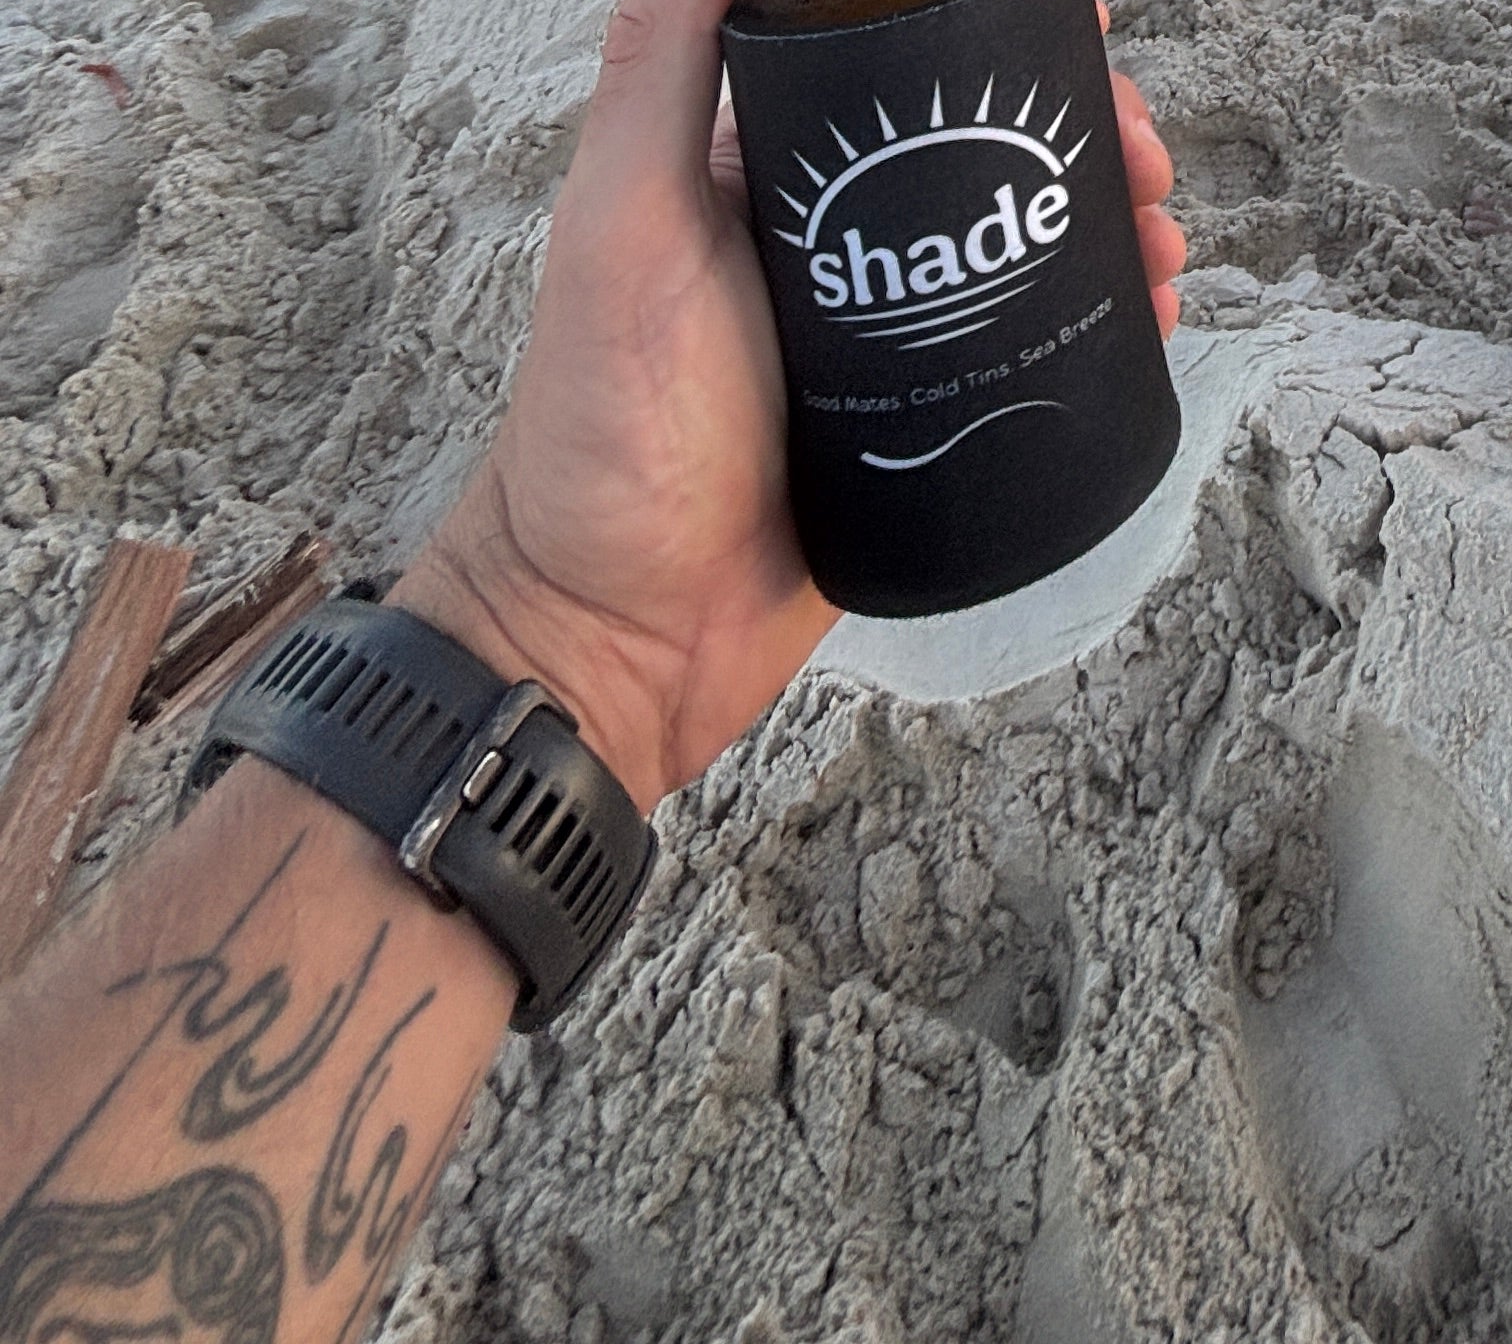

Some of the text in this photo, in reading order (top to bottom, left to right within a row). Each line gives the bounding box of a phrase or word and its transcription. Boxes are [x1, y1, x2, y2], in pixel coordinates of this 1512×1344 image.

[809, 183, 1070, 308] shade
[910, 378, 960, 405] Cold
[1020, 339, 1056, 368] Sea
[1059, 298, 1112, 344] Breeze
